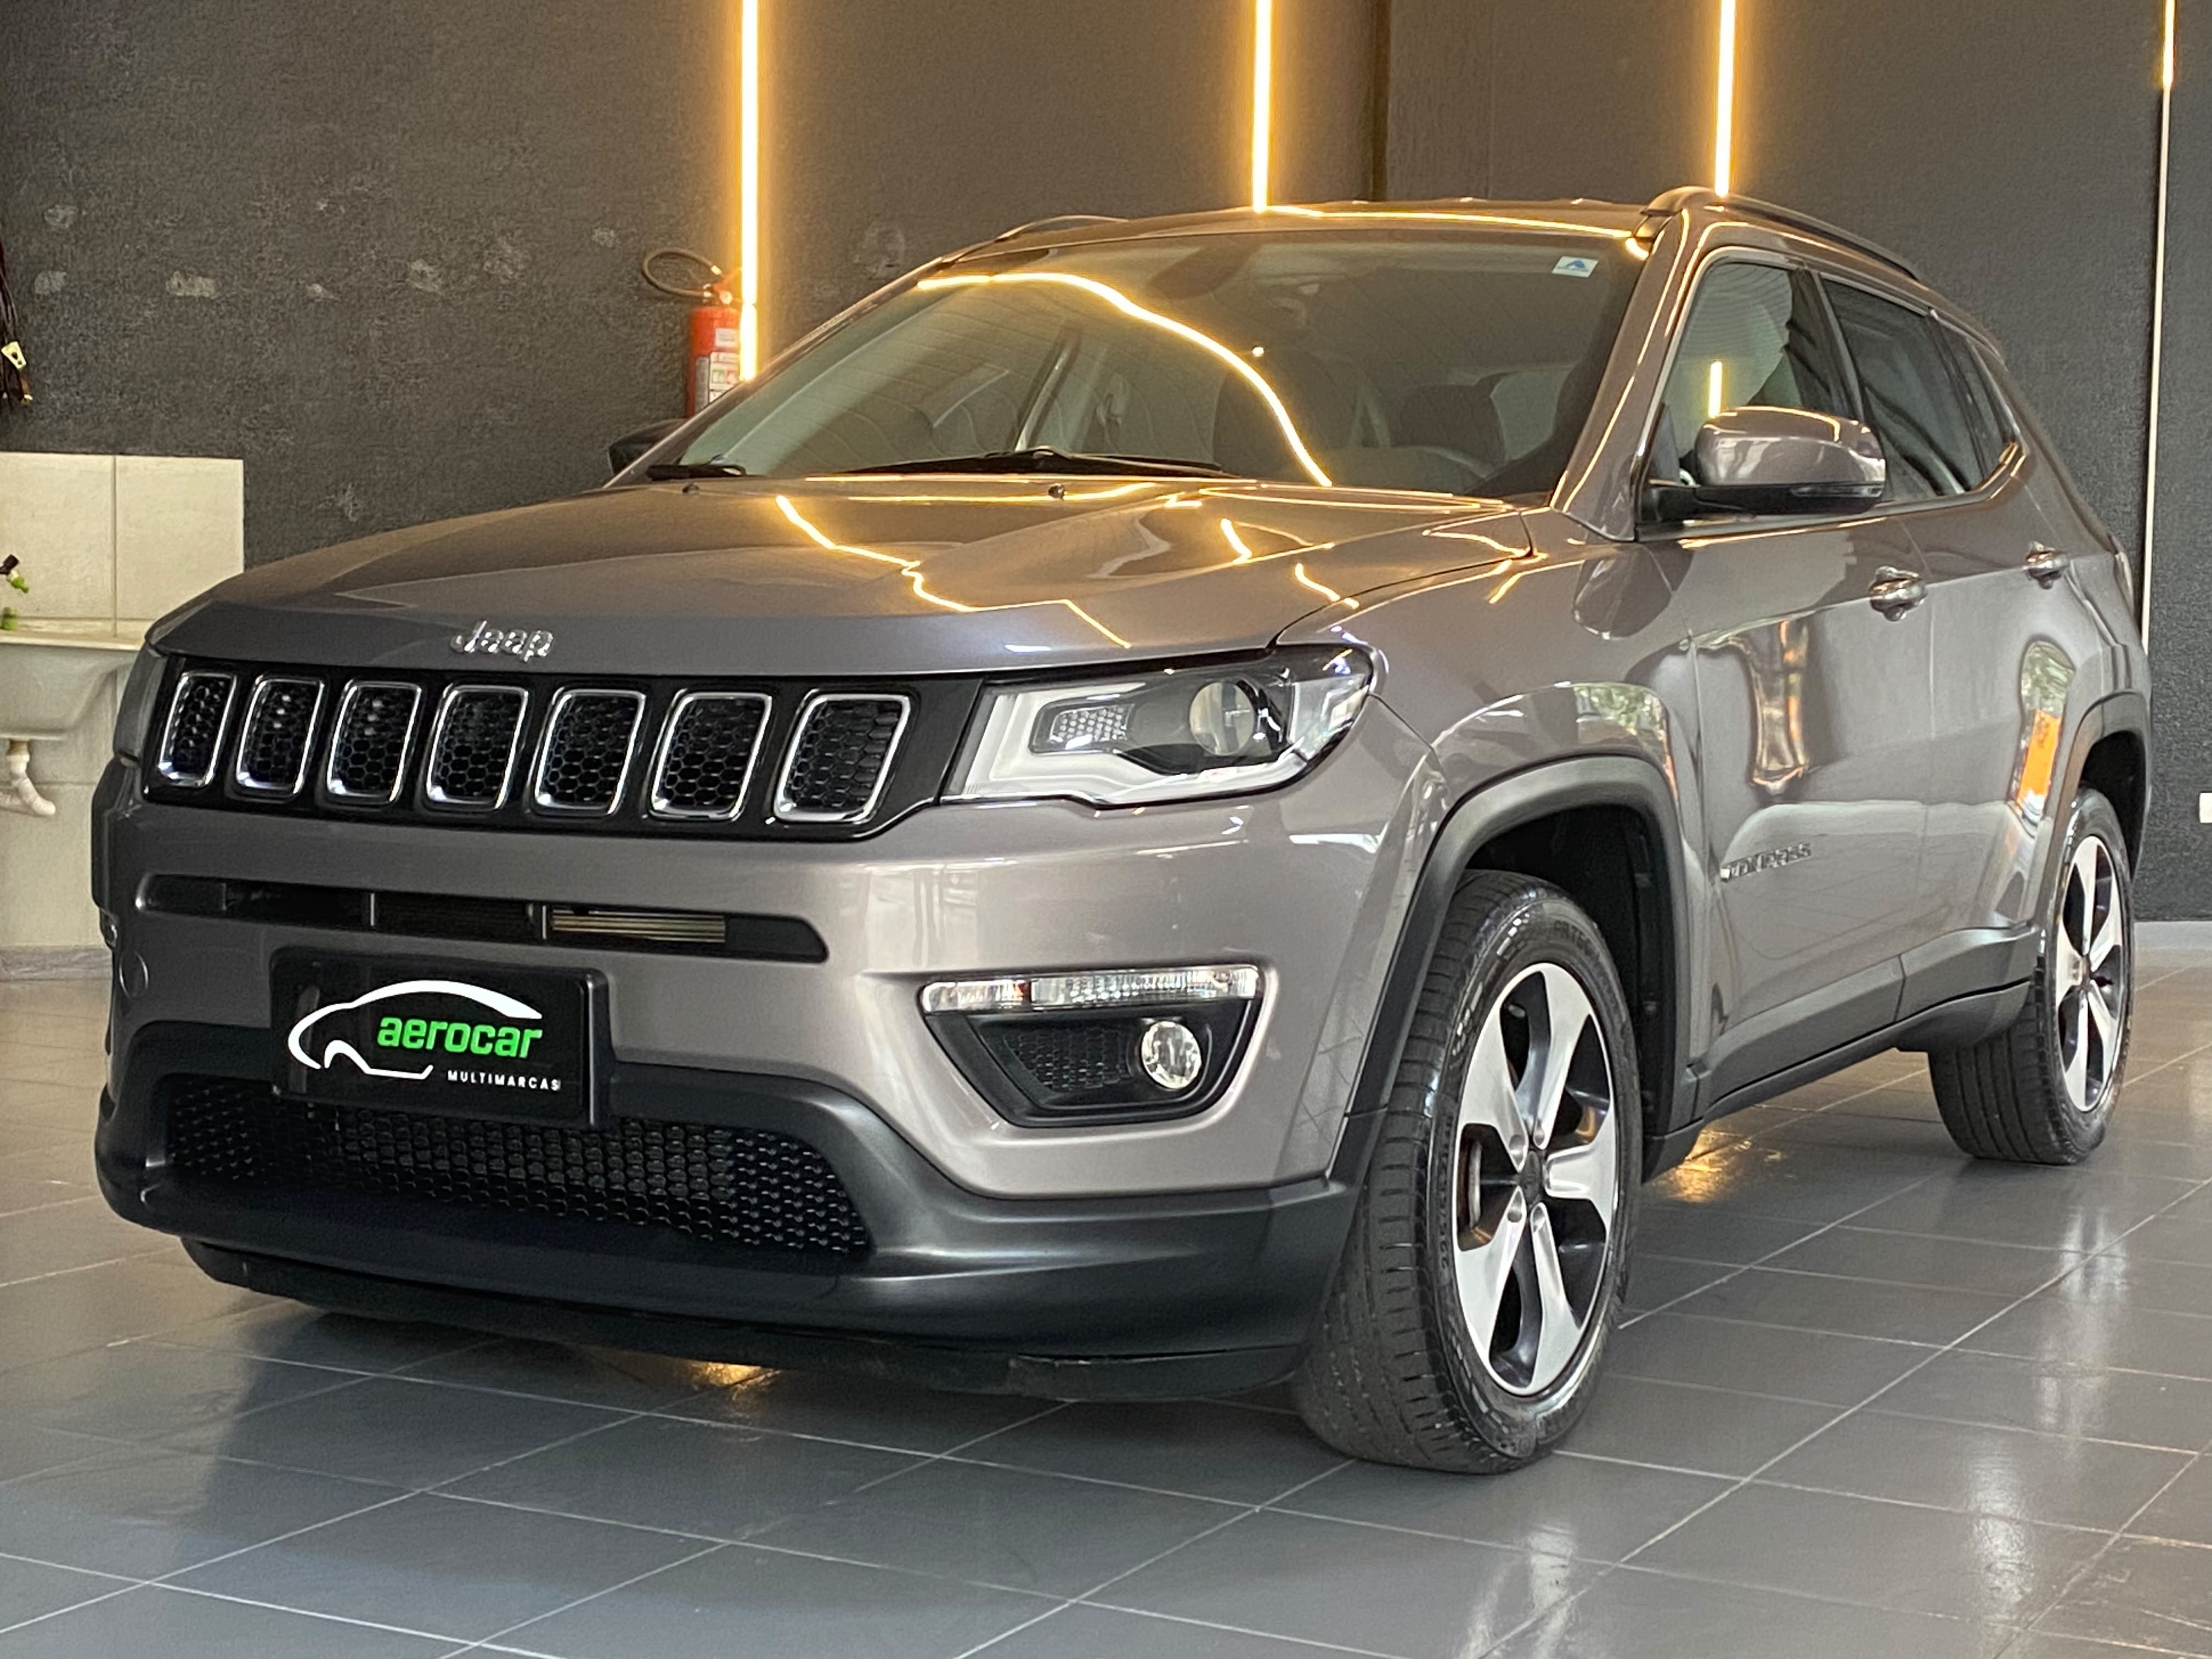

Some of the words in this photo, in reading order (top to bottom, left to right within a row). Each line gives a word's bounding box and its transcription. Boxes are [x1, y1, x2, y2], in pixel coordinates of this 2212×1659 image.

[450, 620, 553, 662] Jeep
[377, 1017, 543, 1058] aerocar
[448, 1070, 561, 1091] MULTIMARCAS
